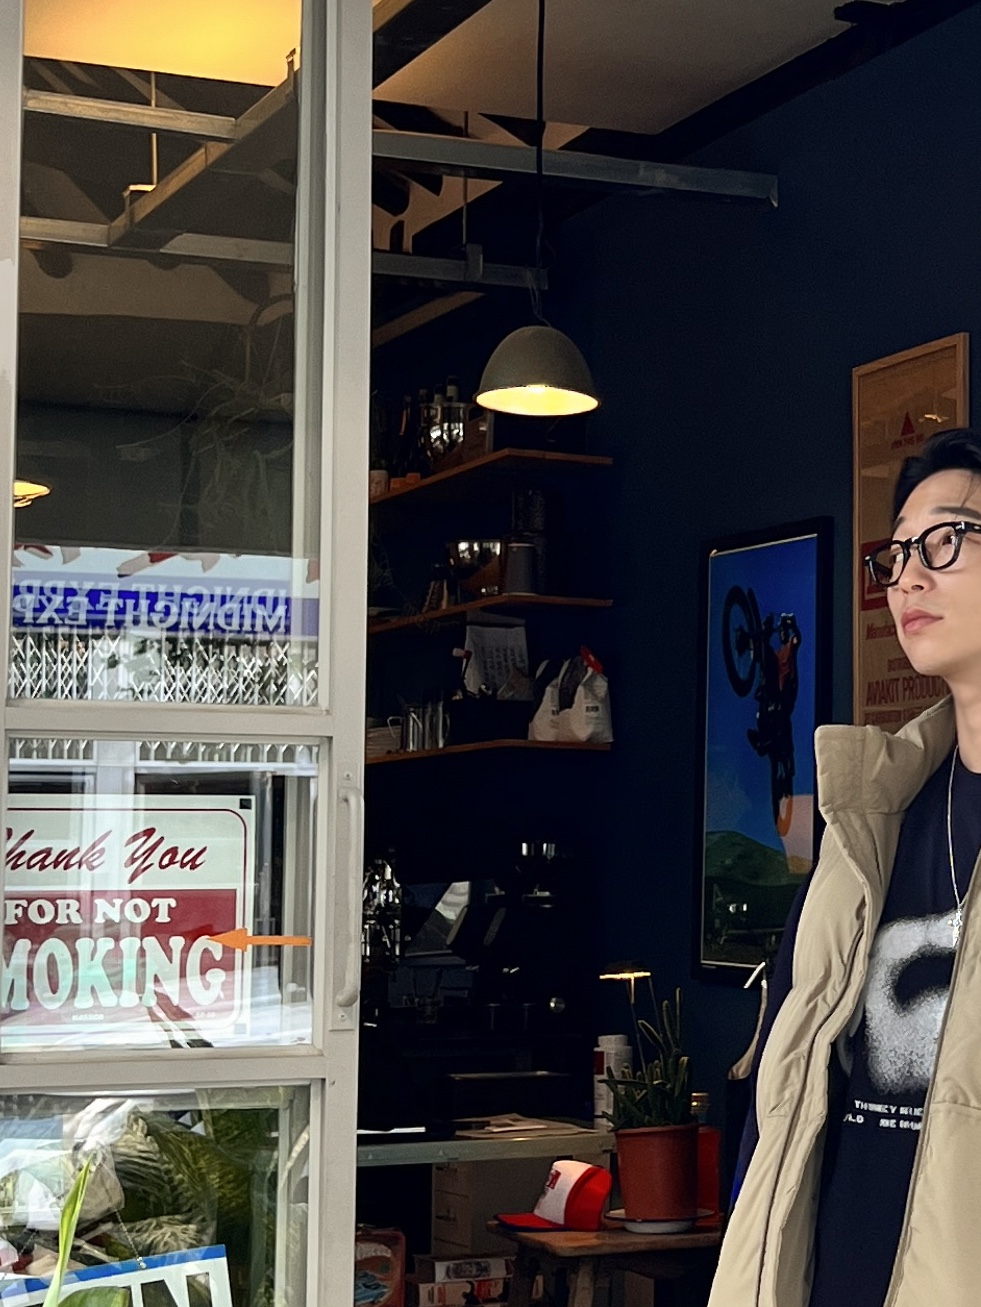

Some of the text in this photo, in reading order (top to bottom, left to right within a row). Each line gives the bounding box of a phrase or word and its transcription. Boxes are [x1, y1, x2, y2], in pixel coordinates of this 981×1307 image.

[6, 827, 208, 884] hank You
[4, 897, 177, 925] FOR NOT
